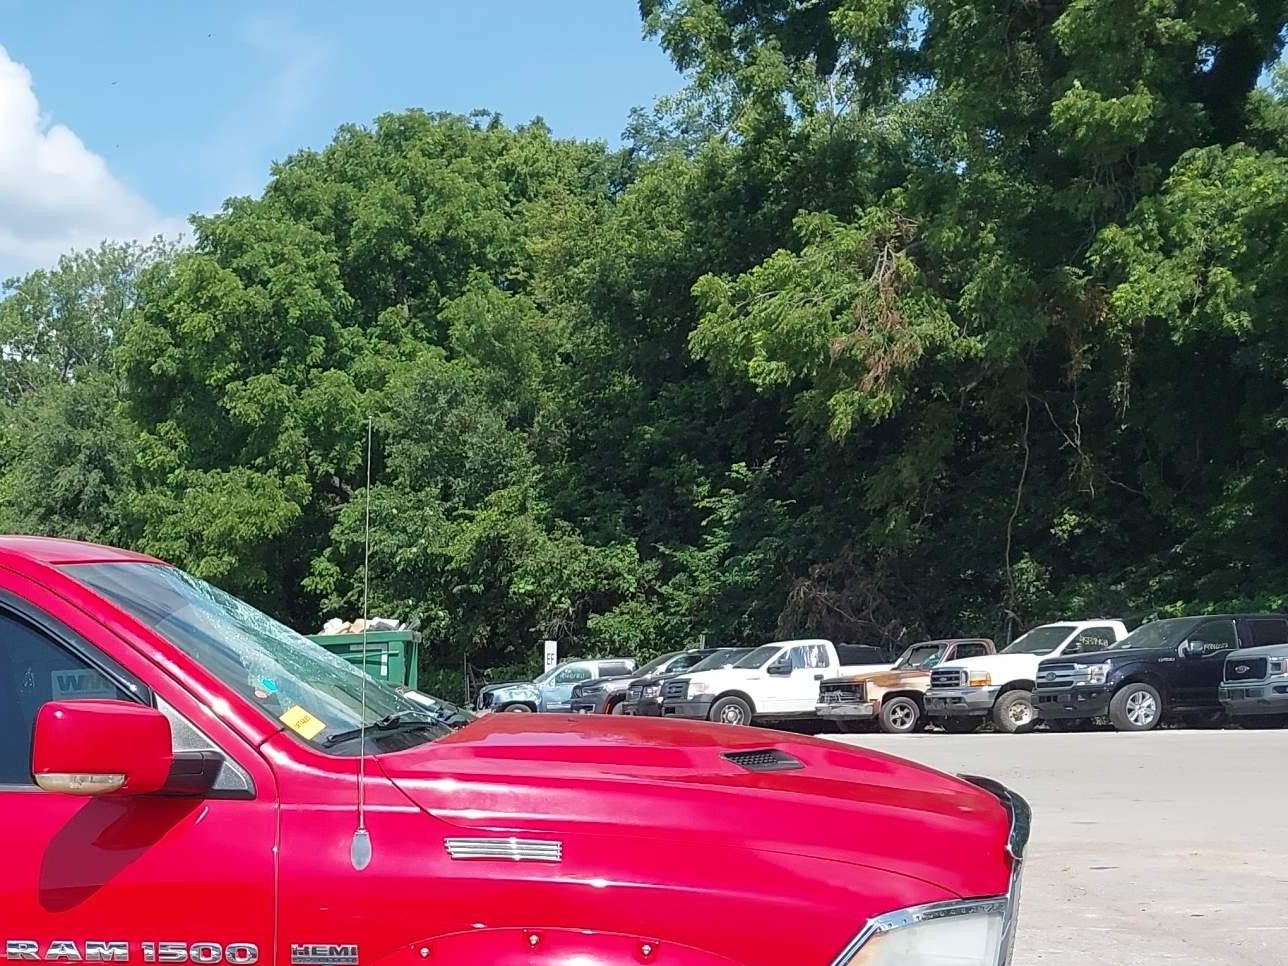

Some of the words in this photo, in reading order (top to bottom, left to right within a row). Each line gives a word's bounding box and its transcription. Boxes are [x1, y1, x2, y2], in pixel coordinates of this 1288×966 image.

[6, 940, 129, 962] RAM
[141, 941, 259, 965] 1500
[291, 944, 358, 956] HEMI
